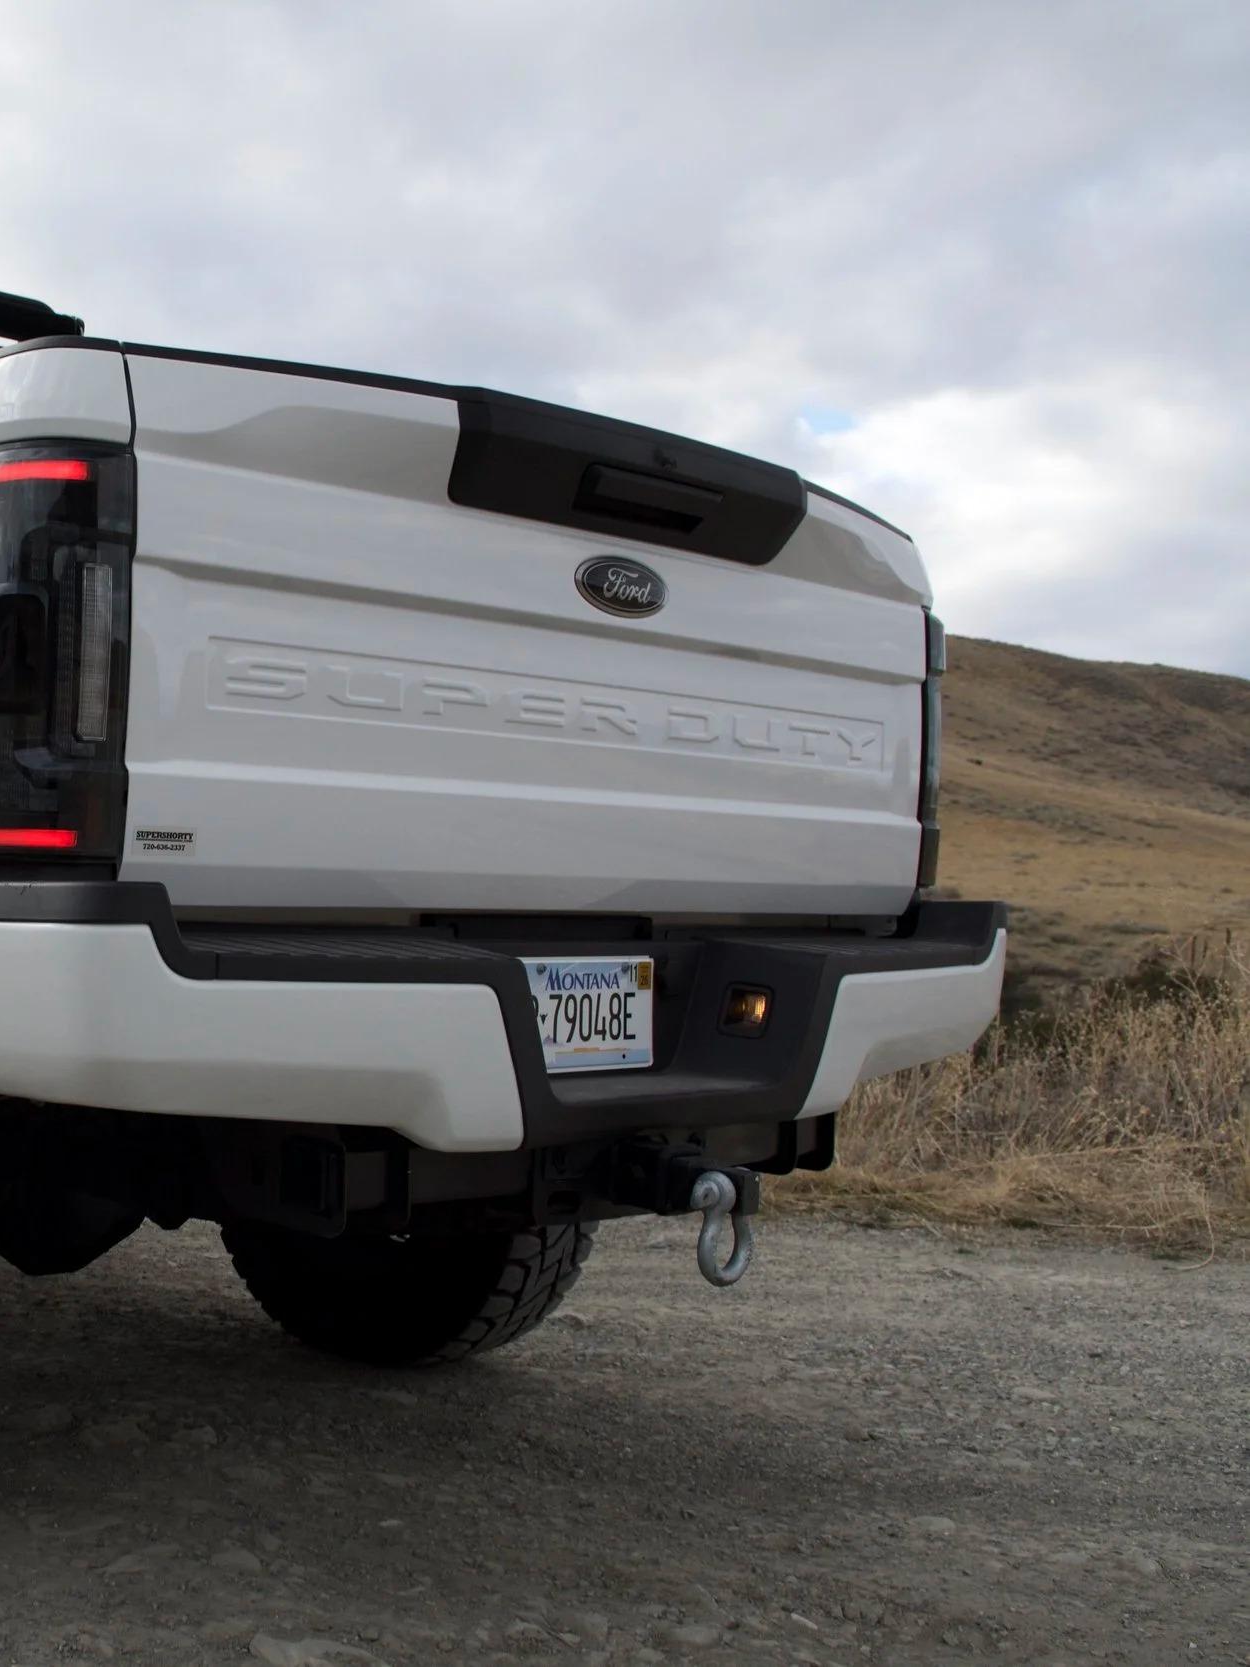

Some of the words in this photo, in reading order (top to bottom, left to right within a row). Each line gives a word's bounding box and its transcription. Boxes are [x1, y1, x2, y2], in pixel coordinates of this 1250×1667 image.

[603, 567, 651, 604] Ford
[224, 656, 638, 736] SUPER
[665, 704, 877, 763] DUTY
[136, 830, 194, 840] SUPERSHORTY
[545, 967, 620, 991] MONTANA
[549, 991, 636, 1044] 79048E
